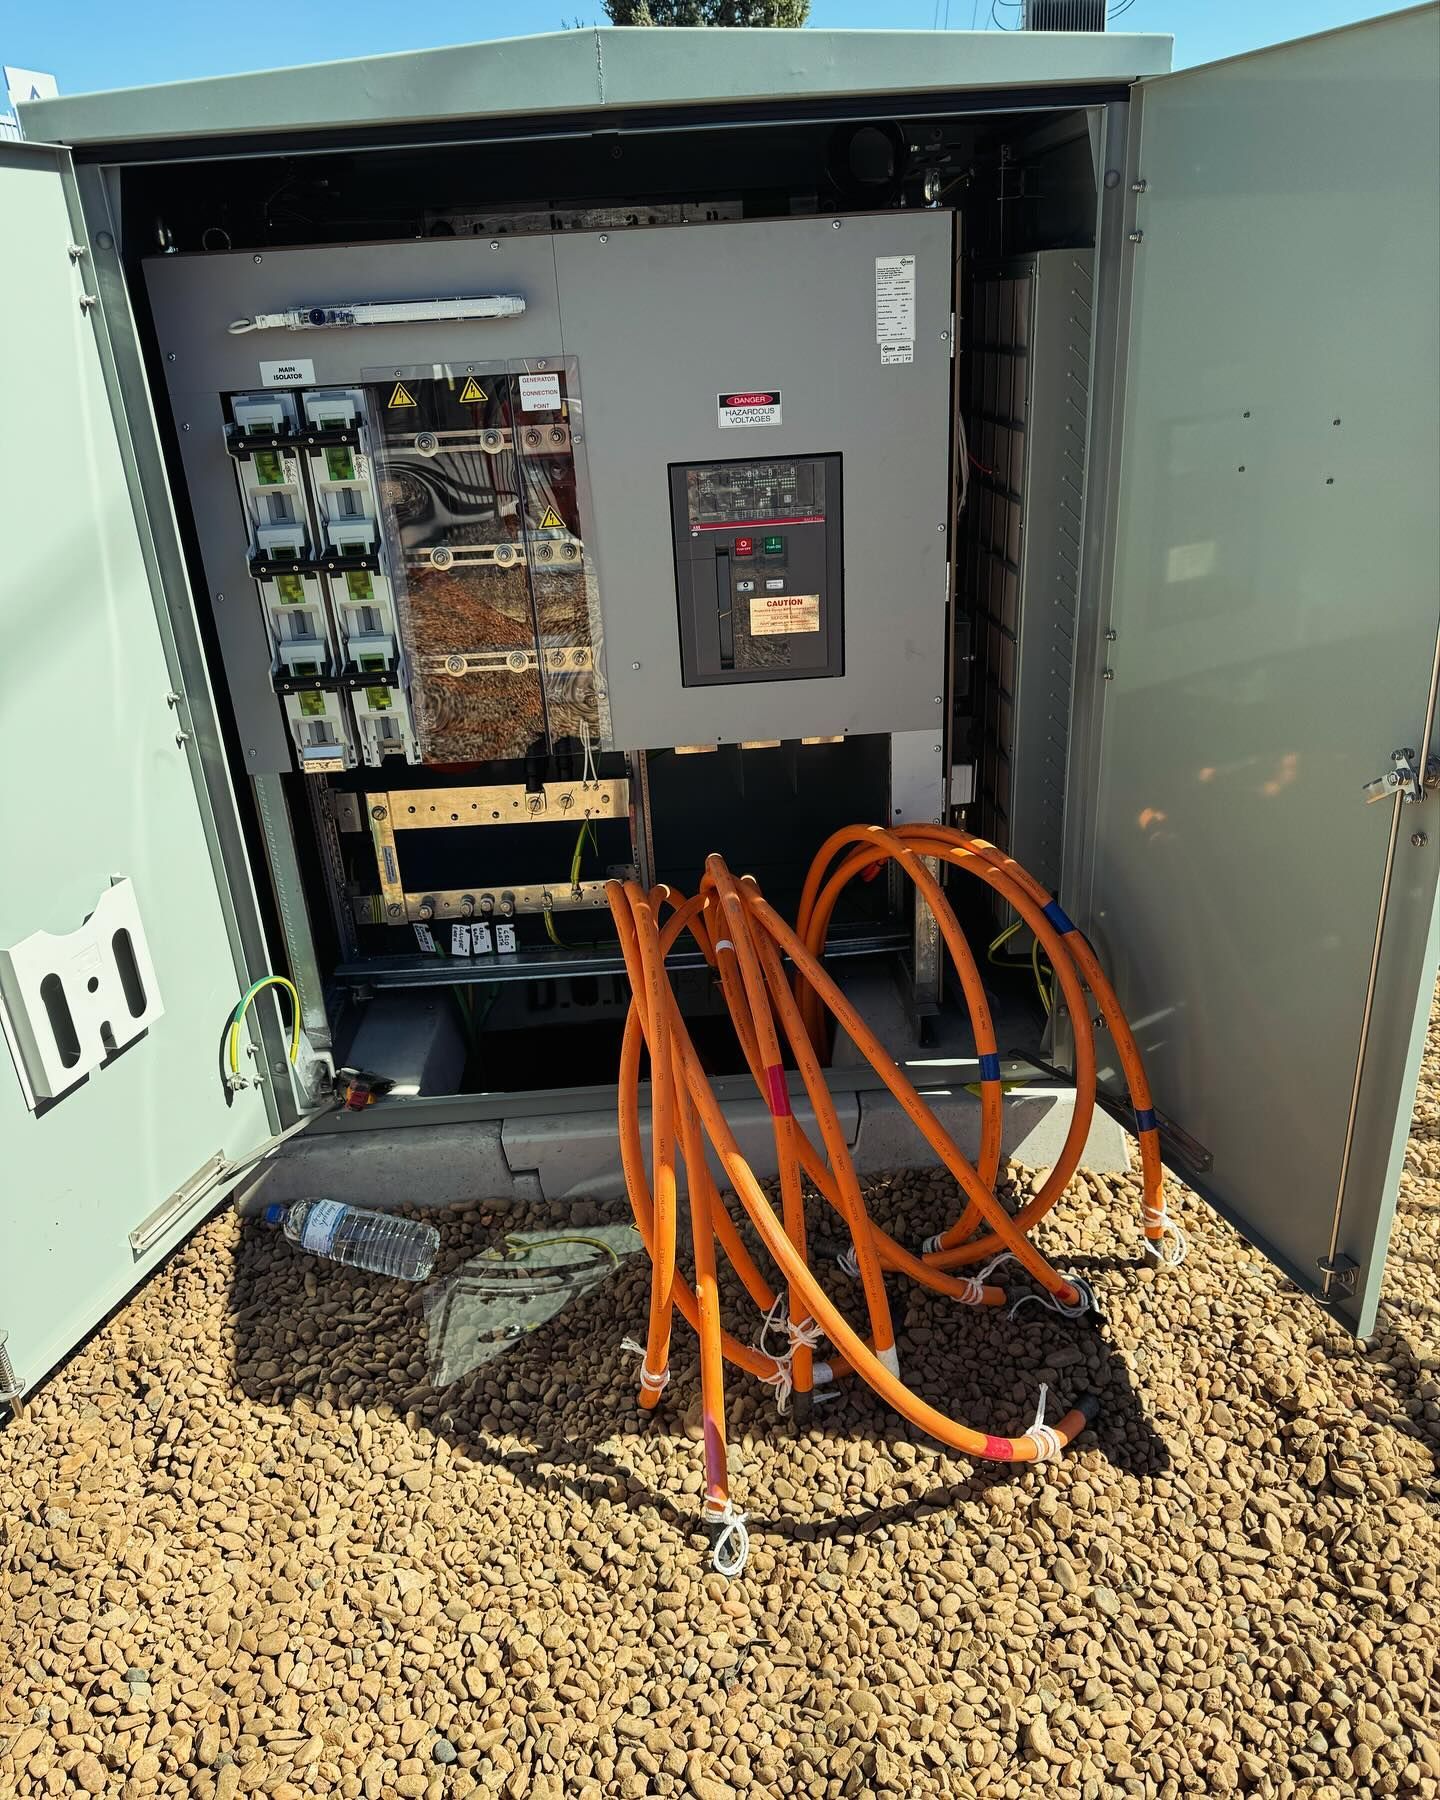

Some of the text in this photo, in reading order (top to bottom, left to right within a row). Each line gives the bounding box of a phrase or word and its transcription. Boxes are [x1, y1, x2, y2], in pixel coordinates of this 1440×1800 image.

[273, 373, 303, 381] ISOLATOR
[522, 389, 558, 397] CONNECTION
[734, 396, 766, 404] DANGER
[725, 407, 775, 416] HAZARDOUS
[730, 415, 771, 424] VOLTAGES
[766, 598, 803, 608] CAUTION
